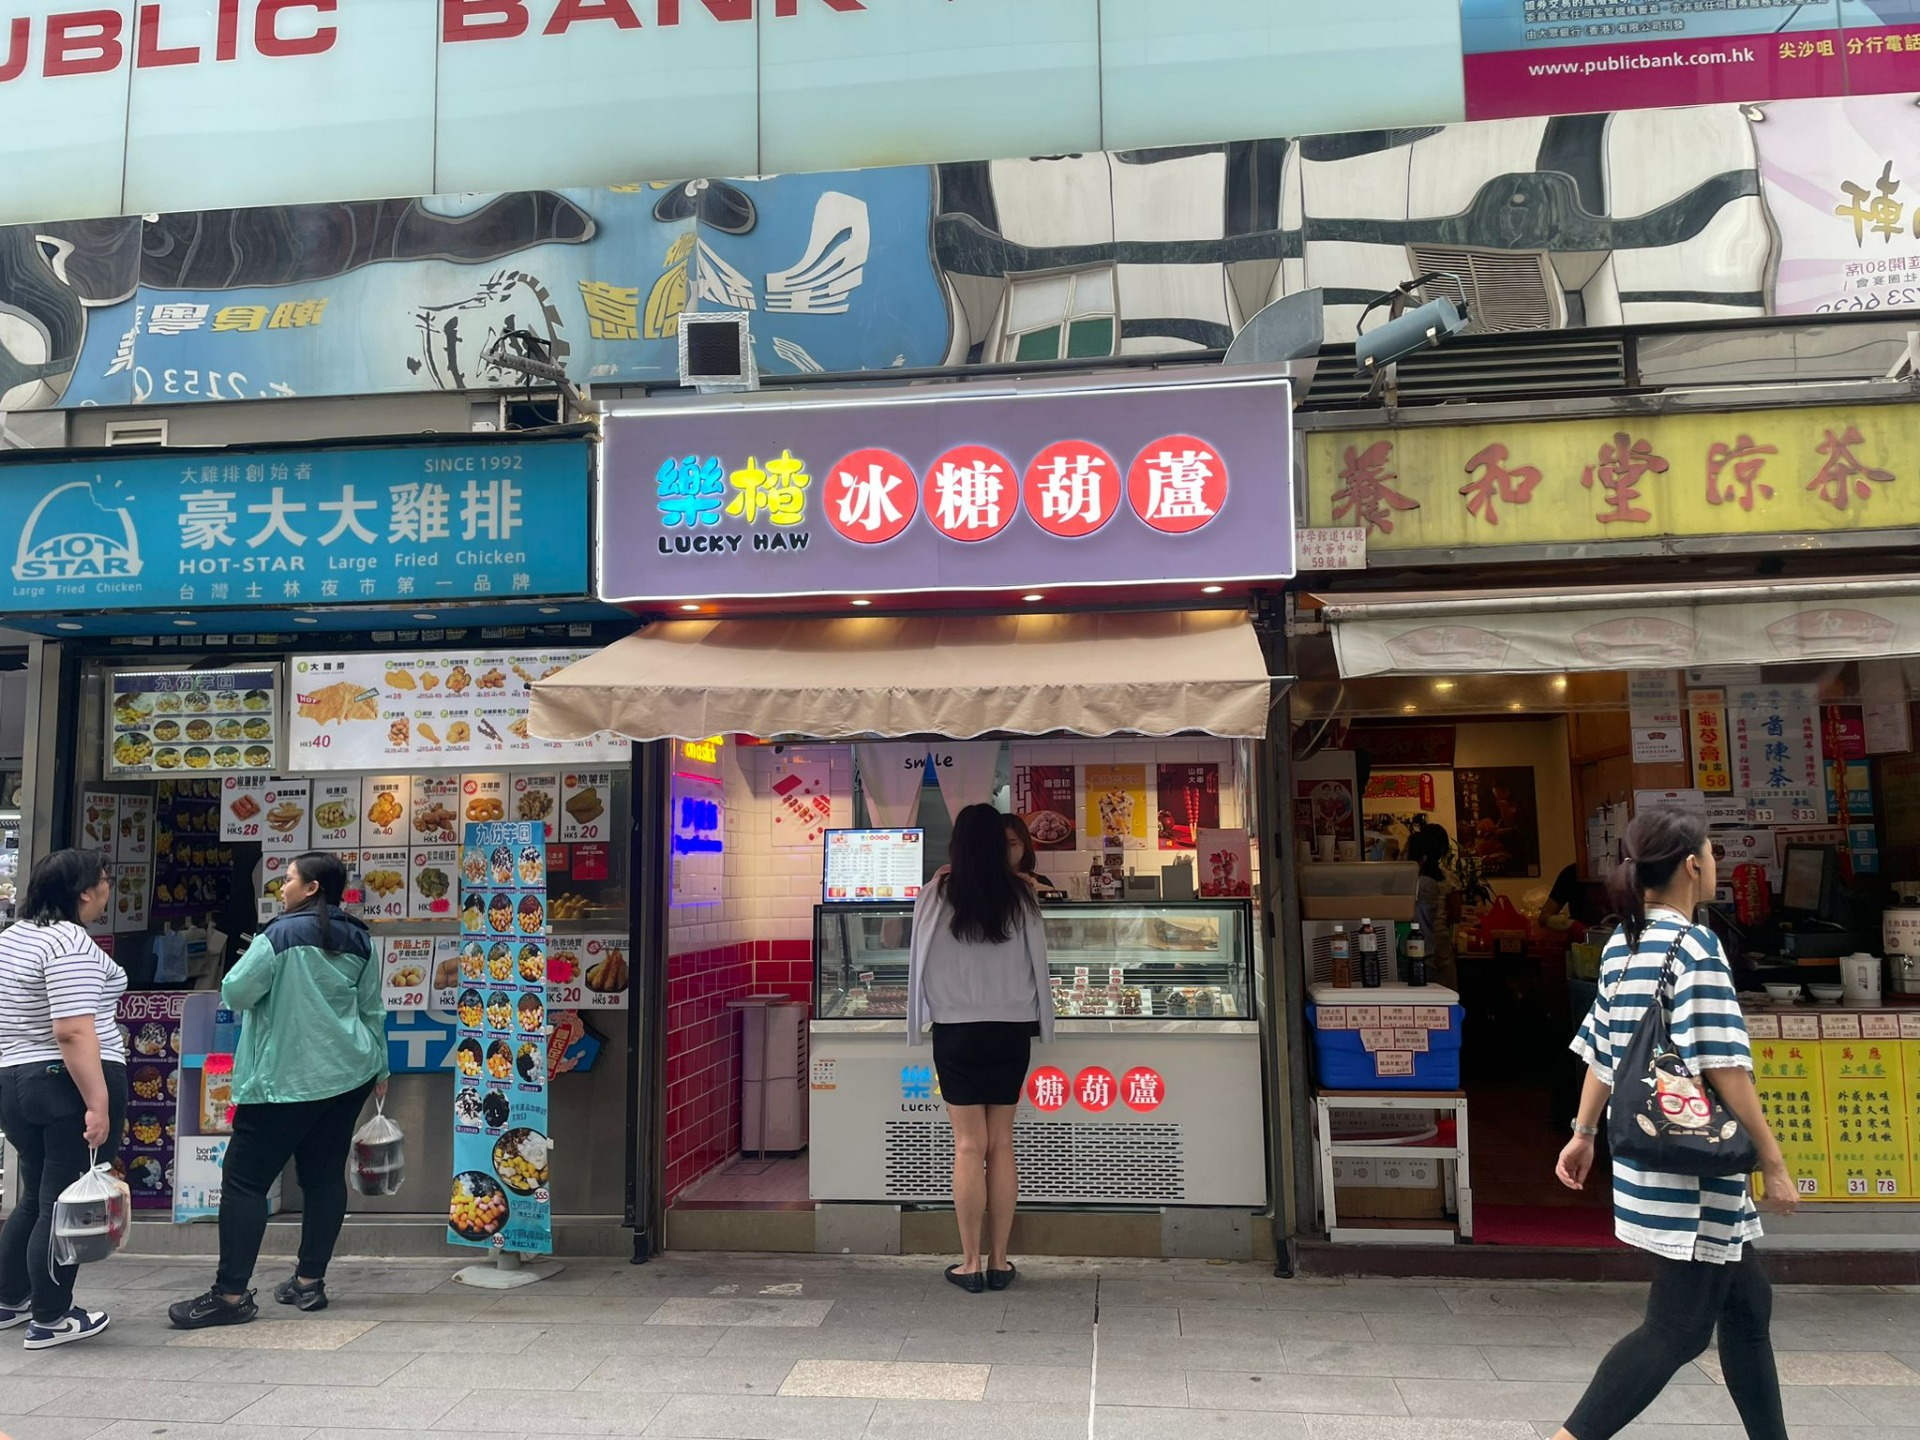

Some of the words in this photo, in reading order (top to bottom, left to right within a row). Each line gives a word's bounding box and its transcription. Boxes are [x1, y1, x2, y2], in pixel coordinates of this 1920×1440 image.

[443, 0, 868, 43] BA
[1779, 40, 1834, 59] 尖沙咀
[1847, 33, 1920, 55] 分行電話
[1529, 47, 1755, 76] www.publicbank.com.hk
[424, 457, 475, 473] SINCE
[479, 455, 523, 471] 1992
[180, 463, 313, 485] 大雞排創始者
[656, 449, 811, 527] 樂楂
[836, 448, 1215, 531] 冰糖葫蘆
[178, 480, 524, 551] 豪大大雞排
[35, 534, 120, 559] HOT
[657, 533, 742, 555] LUCKY
[752, 531, 810, 551] HAW
[22, 558, 128, 578] STAR
[179, 556, 305, 574] HOT-STAR
[329, 554, 378, 573] Large
[394, 551, 439, 567] Fried
[456, 549, 526, 566] Chicken
[12, 584, 45, 597] Large
[56, 583, 85, 594] Fried
[96, 581, 142, 593] Chicken
[180, 574, 531, 600] 台灣士林夜市第一品牌
[299, 696, 318, 705] HOT
[312, 735, 331, 748] 40
[904, 753, 954, 769] smle
[1705, 774, 1727, 788] 58
[227, 827, 243, 835] HK$
[243, 824, 259, 836] 28
[334, 829, 347, 839] 20
[383, 827, 393, 836] 40
[439, 831, 457, 842] 40
[475, 822, 533, 845] 九份芋圓
[580, 825, 598, 839] 20
[282, 833, 294, 843] 40
[363, 905, 381, 915] HK$
[384, 902, 402, 916] 40
[393, 939, 431, 950] 新品上市
[388, 997, 402, 1006] HK$
[403, 993, 423, 1006] 20
[439, 996, 456, 1006] HK$
[563, 988, 581, 1002] 20
[592, 997, 606, 1005] HK$
[607, 995, 620, 1005] 28
[1761, 1063, 1808, 1076] 感冒茶
[1840, 1063, 1886, 1076] 止咳茶
[1035, 1073, 1160, 1107] 糖葫蘆
[901, 1103, 941, 1112] LUCKY
[1799, 1180, 1816, 1191] 78
[1850, 1180, 1866, 1192] 31
[1878, 1180, 1895, 1192] 78
